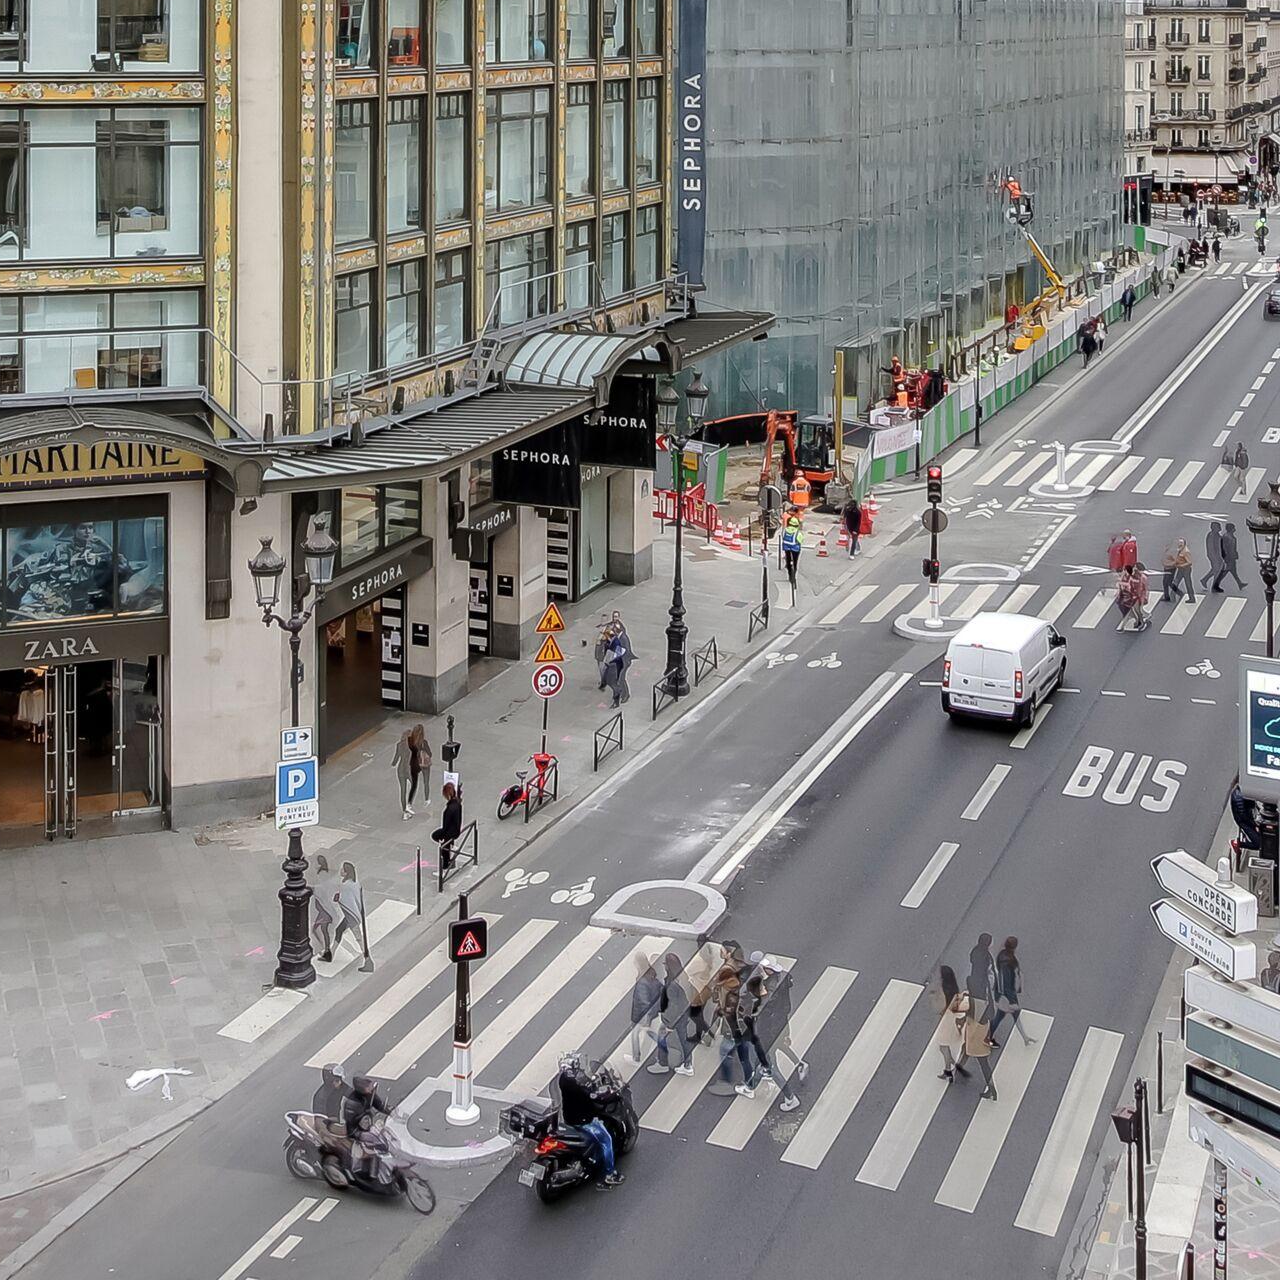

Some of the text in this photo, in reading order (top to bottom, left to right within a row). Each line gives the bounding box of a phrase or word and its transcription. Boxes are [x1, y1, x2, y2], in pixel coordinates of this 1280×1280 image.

[683, 73, 702, 211] SEPHORA
[583, 414, 647, 429] SPHORA
[503, 449, 570, 466] SEPHORA
[352, 564, 403, 600] SEPHORA
[24, 637, 99, 661] ZARA
[540, 673, 558, 688] 30
[288, 769, 306, 797] P
[1062, 745, 1188, 812] BUS
[286, 805, 309, 813] RIVOLI
[1187, 889, 1232, 926] CONCORDE
[1204, 887, 1232, 913] OPÉRA
[1190, 925, 1212, 946] Louvre
[1190, 937, 1230, 971] Samaritaine
